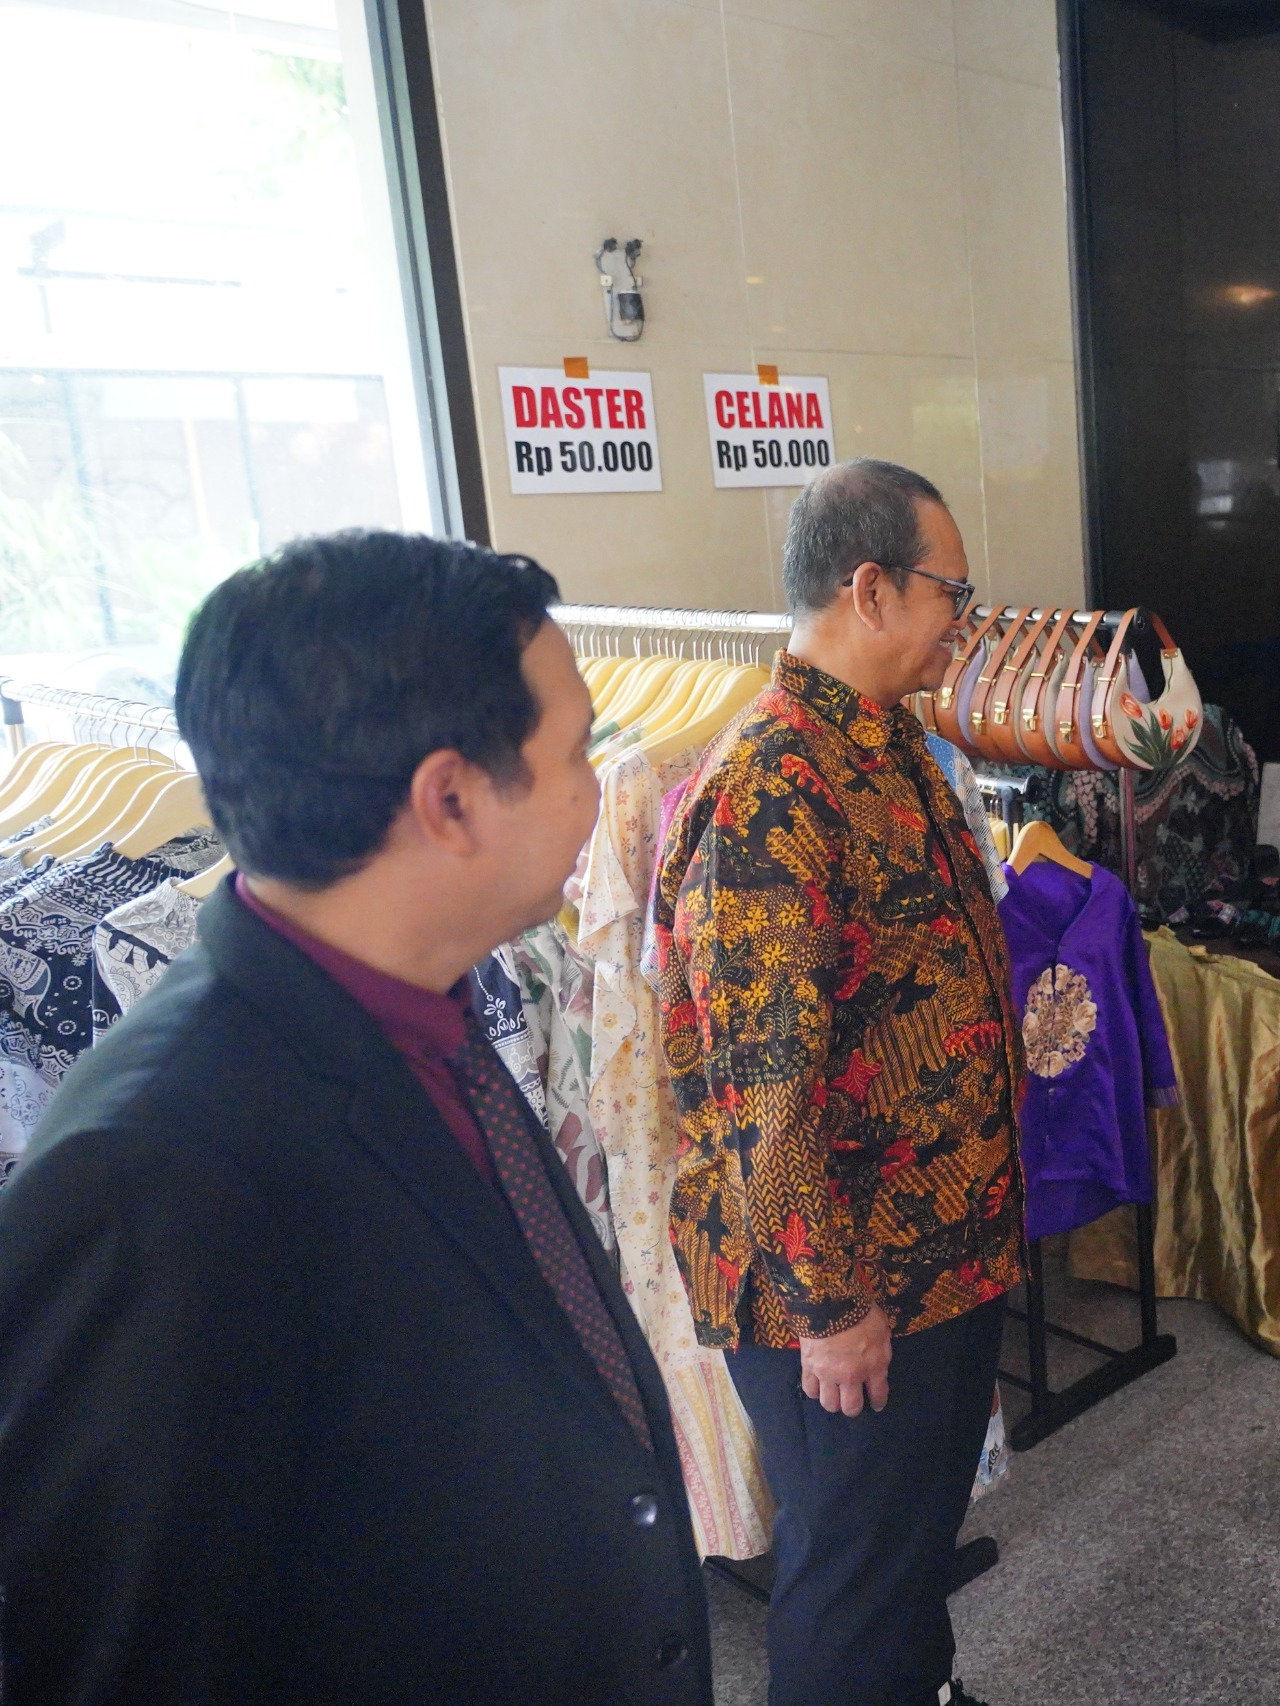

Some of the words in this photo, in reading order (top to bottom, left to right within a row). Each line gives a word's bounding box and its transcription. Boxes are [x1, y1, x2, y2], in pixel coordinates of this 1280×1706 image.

[512, 386, 646, 429] DASTER
[715, 390, 824, 429] CELANA
[515, 440, 553, 476] Rp
[559, 440, 653, 473] 50.000
[716, 440, 748, 471] Rp
[752, 439, 830, 468] 50.000
